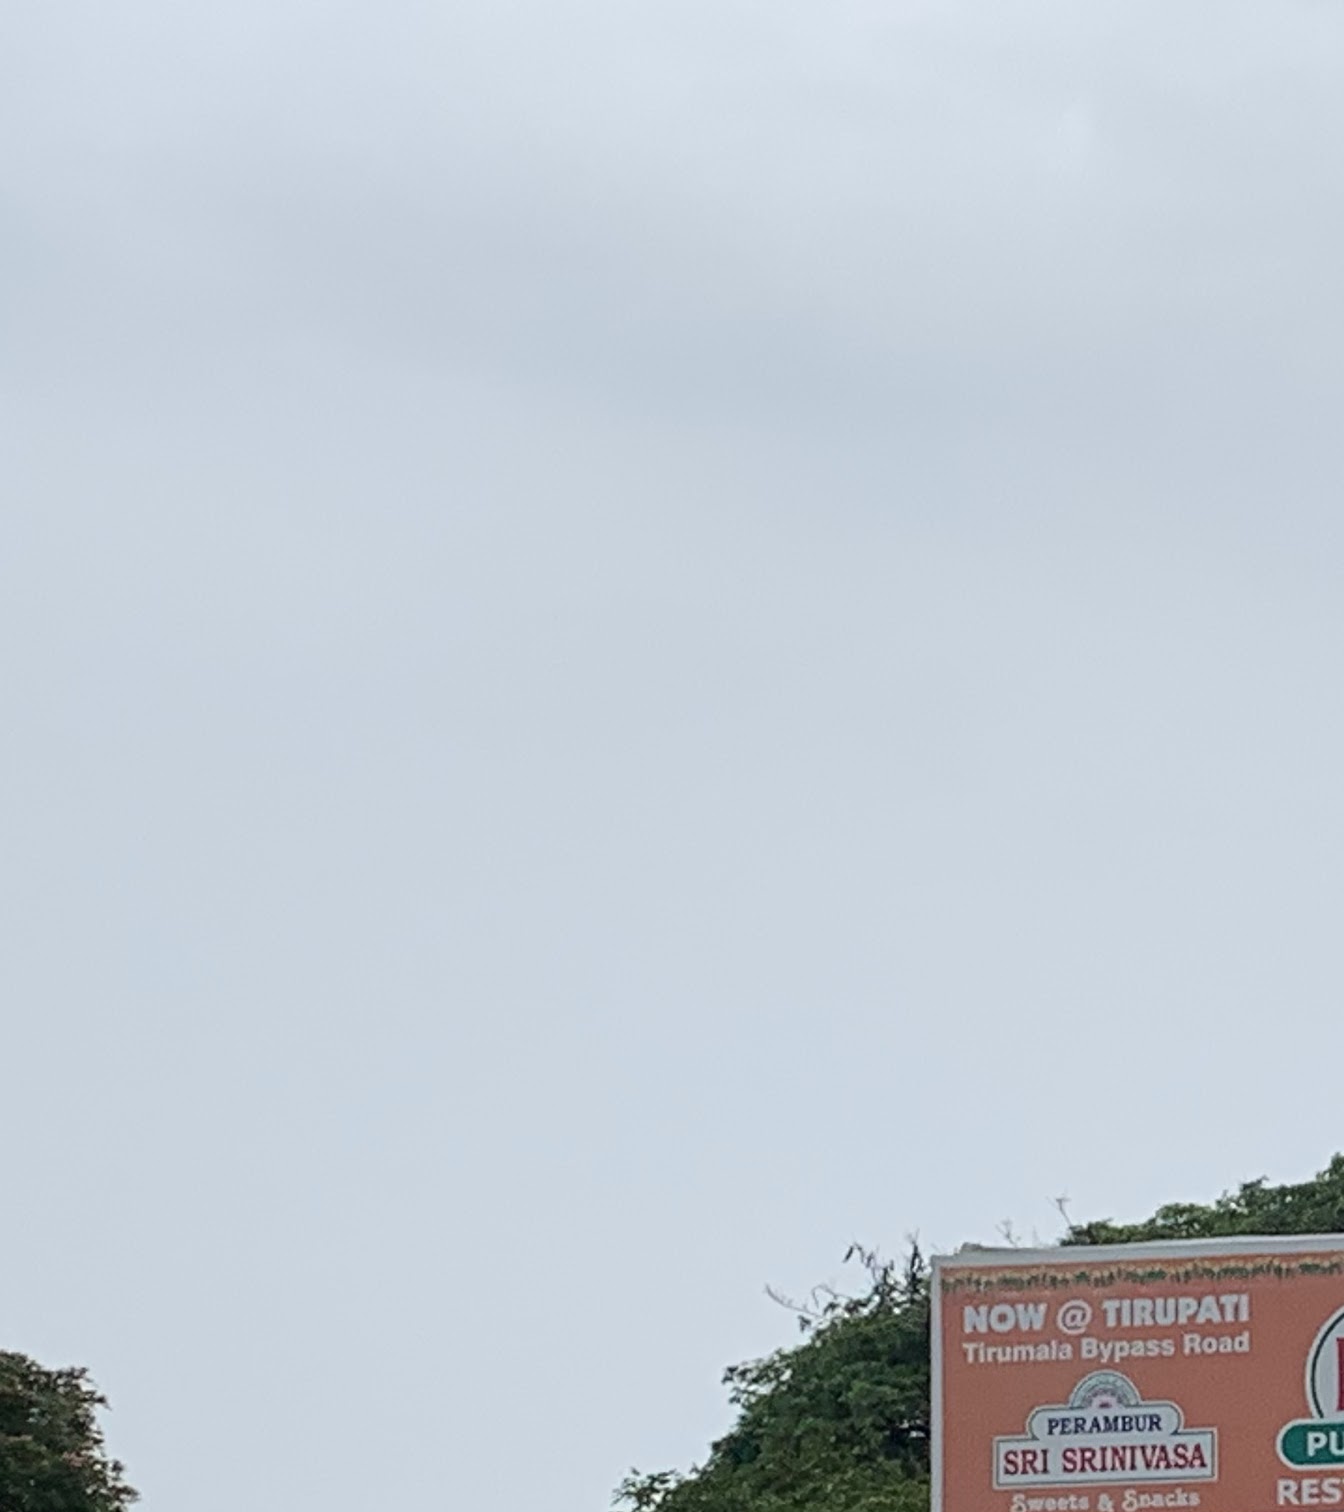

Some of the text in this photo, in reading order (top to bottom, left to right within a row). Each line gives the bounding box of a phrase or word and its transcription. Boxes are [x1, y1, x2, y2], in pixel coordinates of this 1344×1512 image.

[963, 1293, 1250, 1335] NOW @ TIRUPATI
[962, 1331, 1250, 1363] Tirumala Bypass Road
[1047, 1414, 1162, 1435] PERAMBUR
[1003, 1443, 1208, 1475] SRI SRINIVASA
[1121, 1487, 1201, 1512] Snacks
